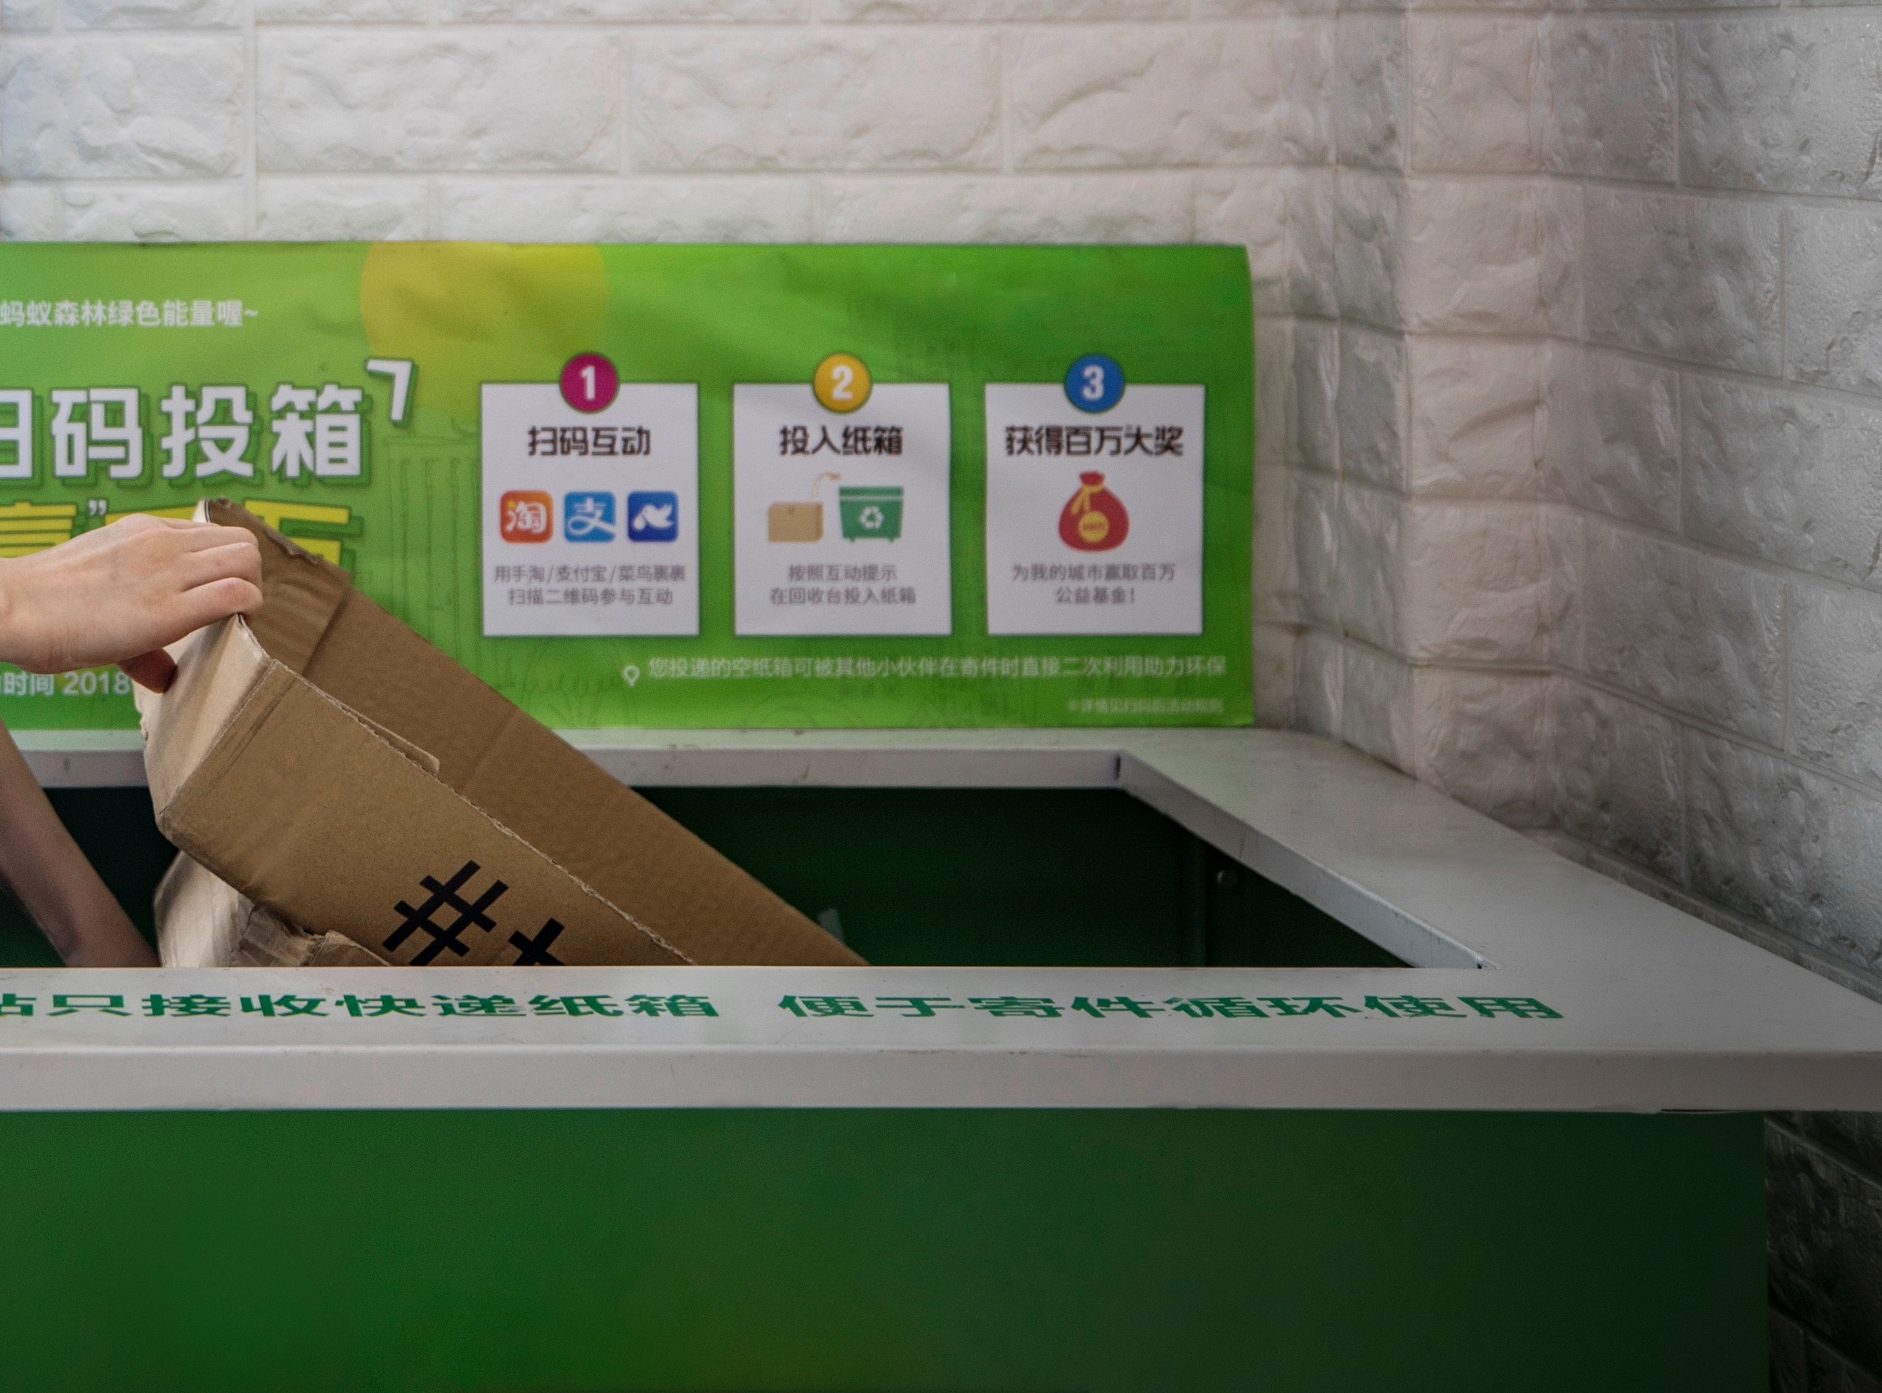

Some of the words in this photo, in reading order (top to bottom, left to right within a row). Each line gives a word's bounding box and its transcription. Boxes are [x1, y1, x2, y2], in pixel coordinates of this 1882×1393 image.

[581, 365, 595, 401] 1
[831, 365, 854, 400] 2
[1082, 365, 1106, 401] 3
[528, 426, 652, 456] 扫码互动
[780, 426, 904, 456] 投入纸箱
[1005, 425, 1185, 456] 获得百万大奖
[789, 564, 898, 582] 按照互动提示
[508, 587, 674, 606] 扫描二维码参与互动
[770, 586, 917, 605] 在回收台投入纸箱
[63, 670, 131, 695] 2018
[776, 993, 1565, 1020] 便于寄件循环使用
